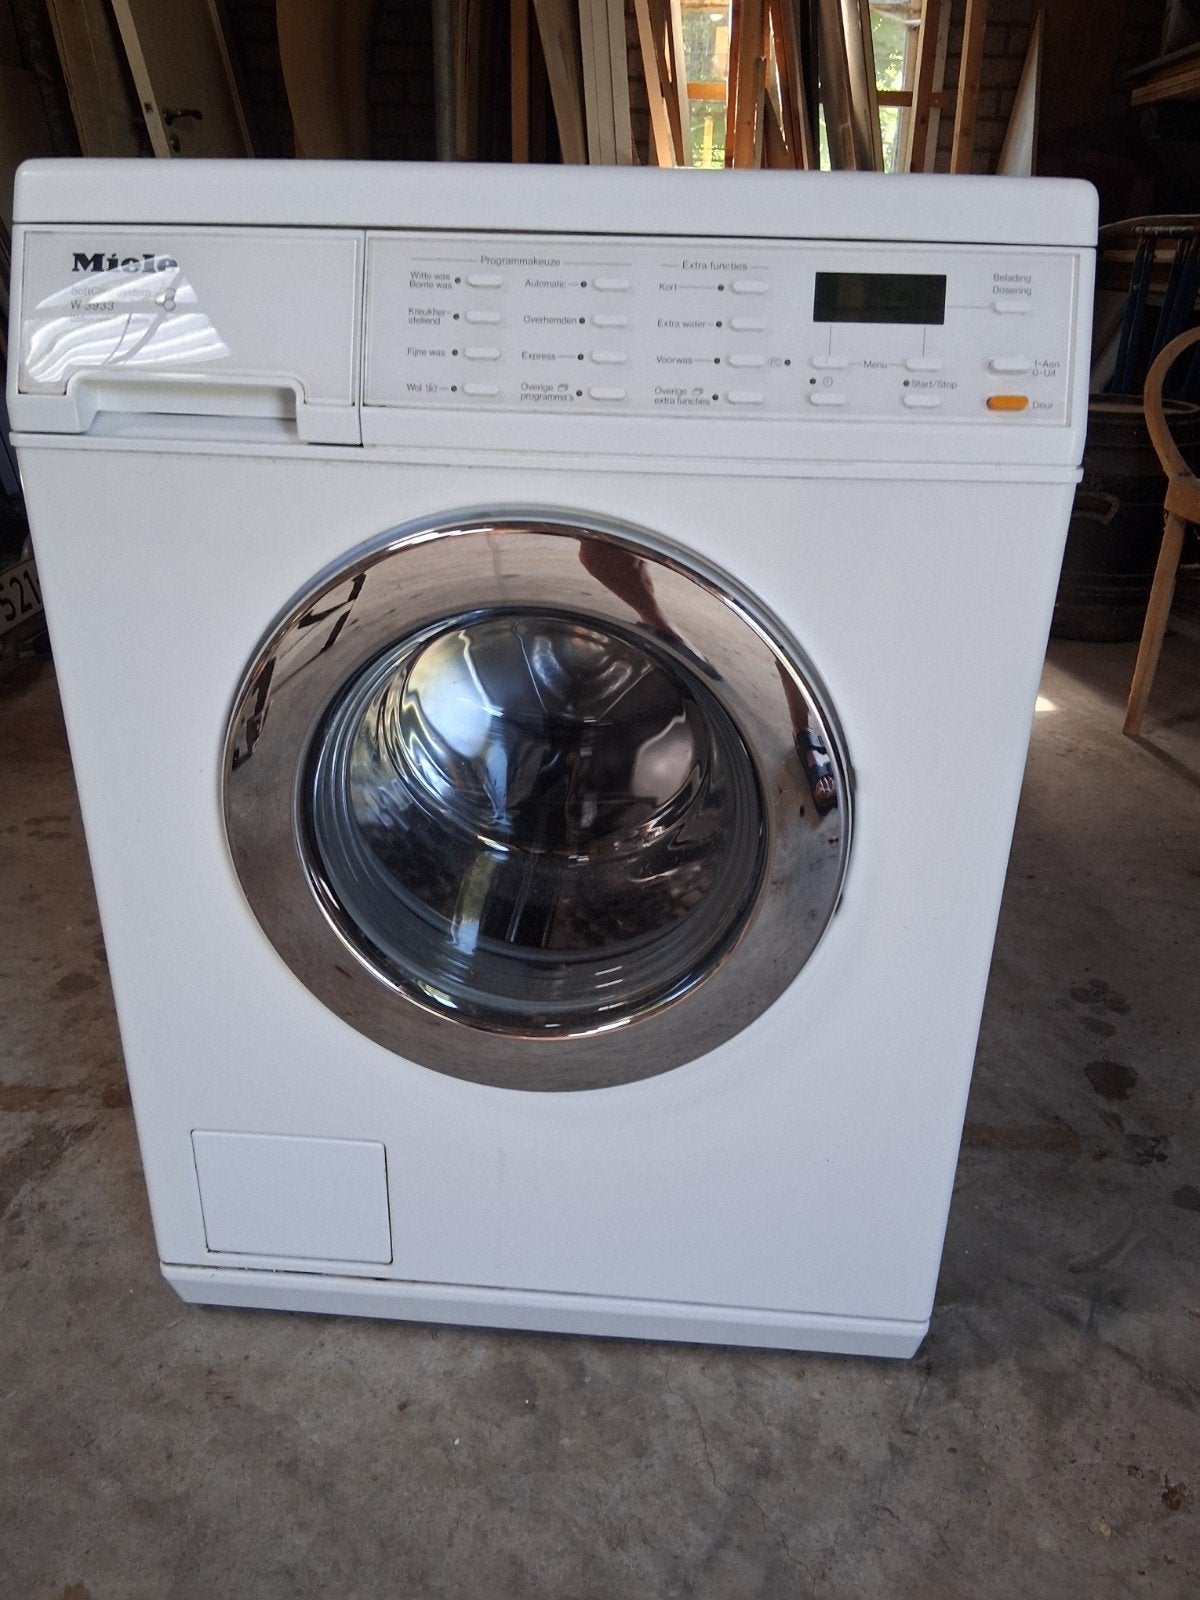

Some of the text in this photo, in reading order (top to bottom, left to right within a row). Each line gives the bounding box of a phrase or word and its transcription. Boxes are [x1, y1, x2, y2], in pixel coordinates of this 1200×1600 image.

[72, 253, 178, 273] Miele
[480, 255, 561, 268] Programmakeuze
[682, 261, 748, 271] Extra functies
[410, 271, 450, 281] Witte was
[993, 273, 1031, 284] Belading
[409, 280, 434, 289] Bonte
[525, 279, 566, 289] Automatic
[658, 283, 678, 291] Kort
[992, 285, 1031, 296] Dosering
[70, 300, 82, 310] W
[523, 315, 578, 325] Overhemden
[657, 319, 706, 328] Extra water
[407, 347, 446, 357] Fijne was
[521, 352, 556, 362] Express
[656, 356, 693, 365] Voorwas
[863, 360, 888, 369] Menu
[407, 383, 422, 391] Wol
[521, 382, 554, 392] Overige
[911, 380, 958, 390] Start/Stop
[654, 386, 687, 396] Overige
[654, 397, 710, 406] extra functies
[1032, 400, 1055, 409] Deur
